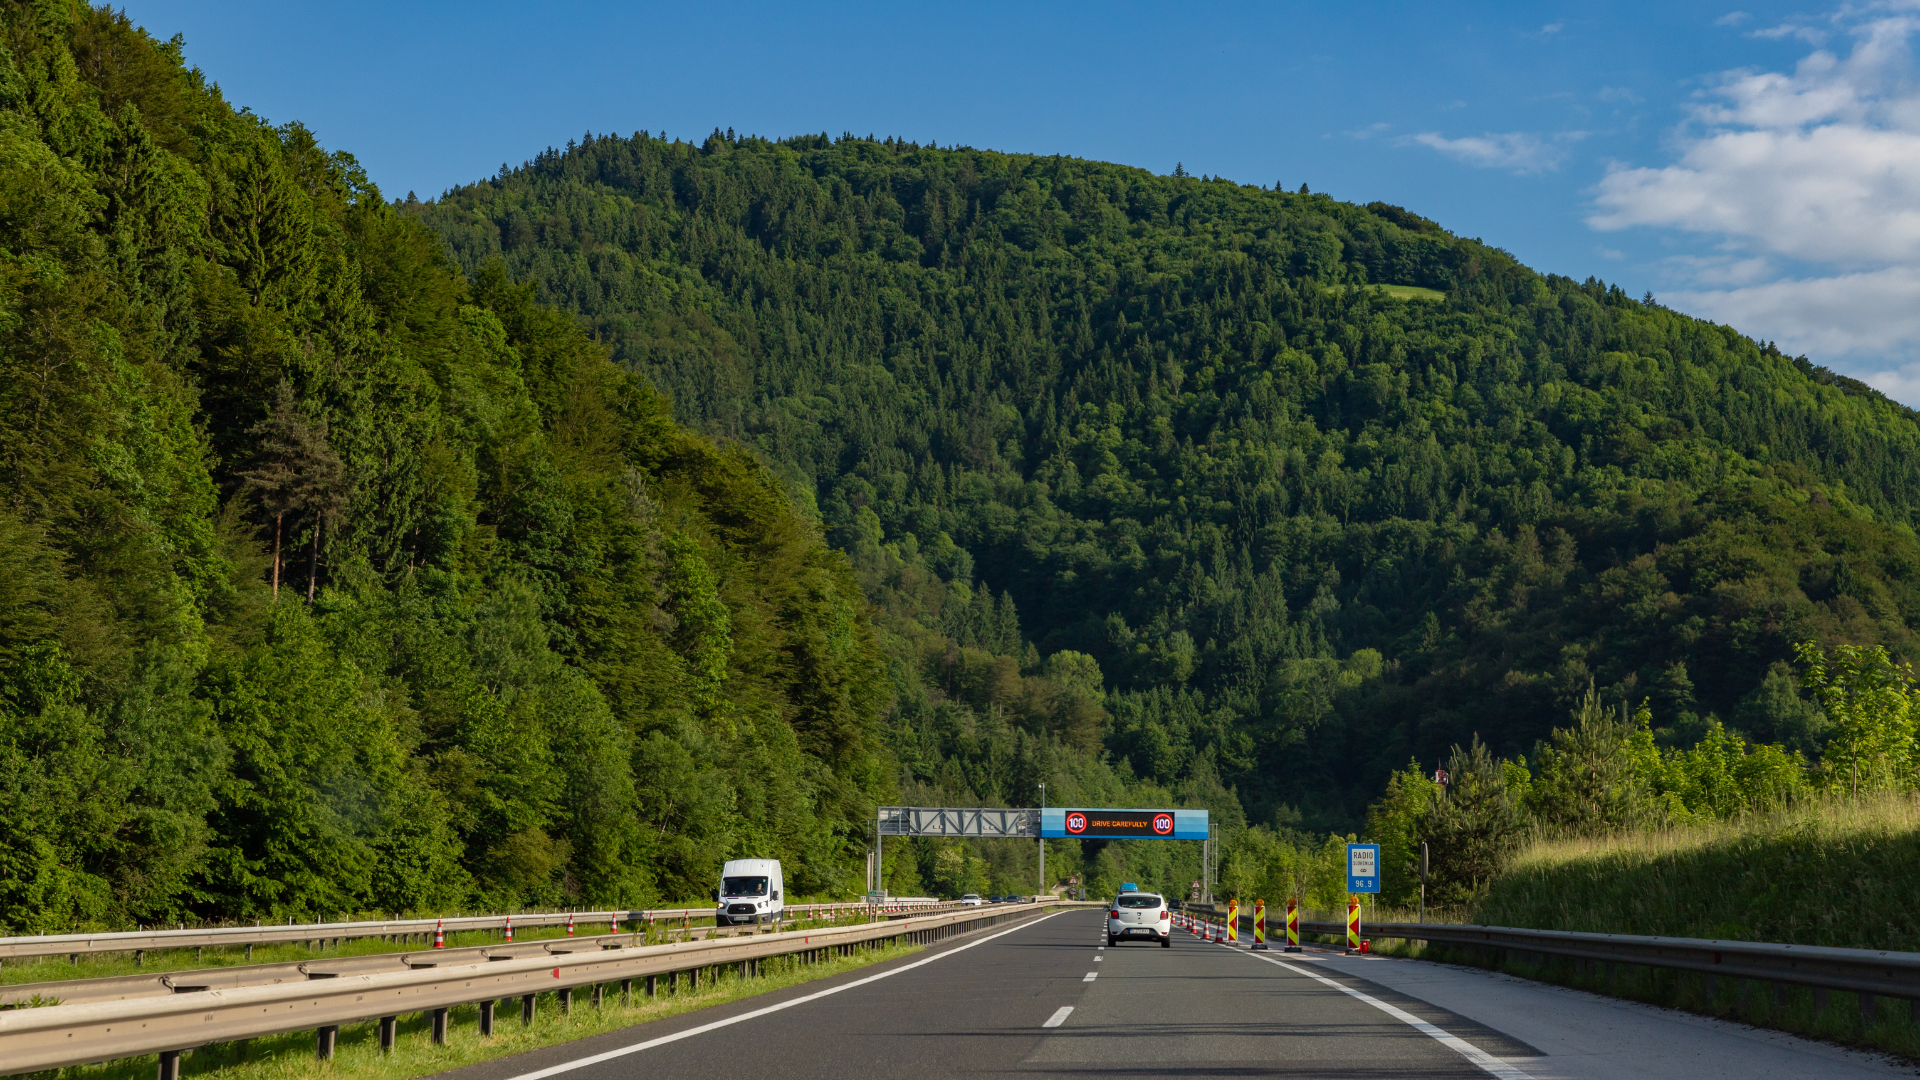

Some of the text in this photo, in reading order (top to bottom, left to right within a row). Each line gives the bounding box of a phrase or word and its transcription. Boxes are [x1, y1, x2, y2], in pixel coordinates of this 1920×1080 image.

[1069, 818, 1084, 828] 100
[1155, 819, 1170, 829] 100
[1355, 880, 1372, 888] 96.9
